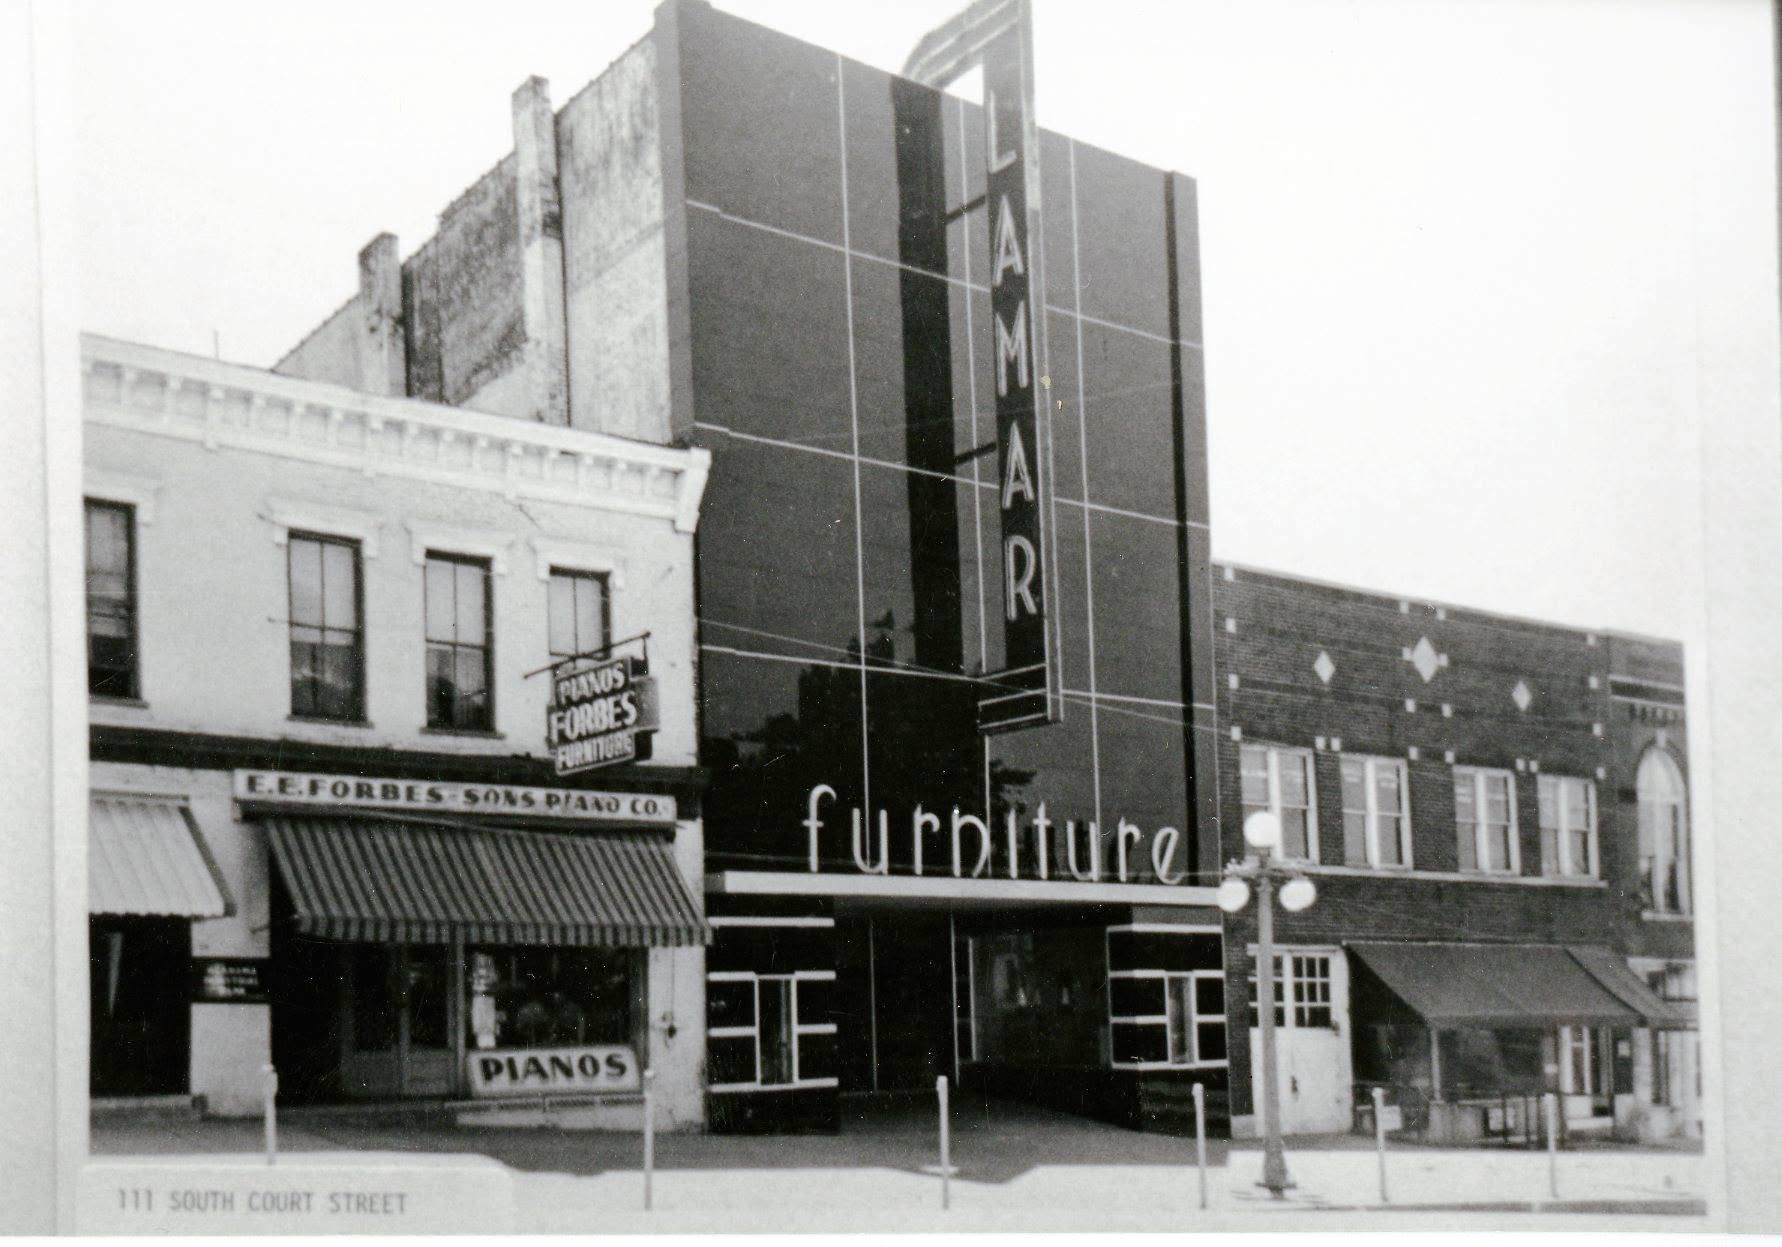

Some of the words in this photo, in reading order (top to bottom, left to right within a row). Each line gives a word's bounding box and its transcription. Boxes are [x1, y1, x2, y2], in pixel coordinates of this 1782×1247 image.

[988, 89, 1038, 622] LAMAR
[559, 662, 625, 706] PIANOS
[549, 690, 638, 745] FORBES
[545, 792, 620, 813] PIANO
[802, 784, 1185, 885] furniture
[480, 1054, 627, 1082] PIANOS
